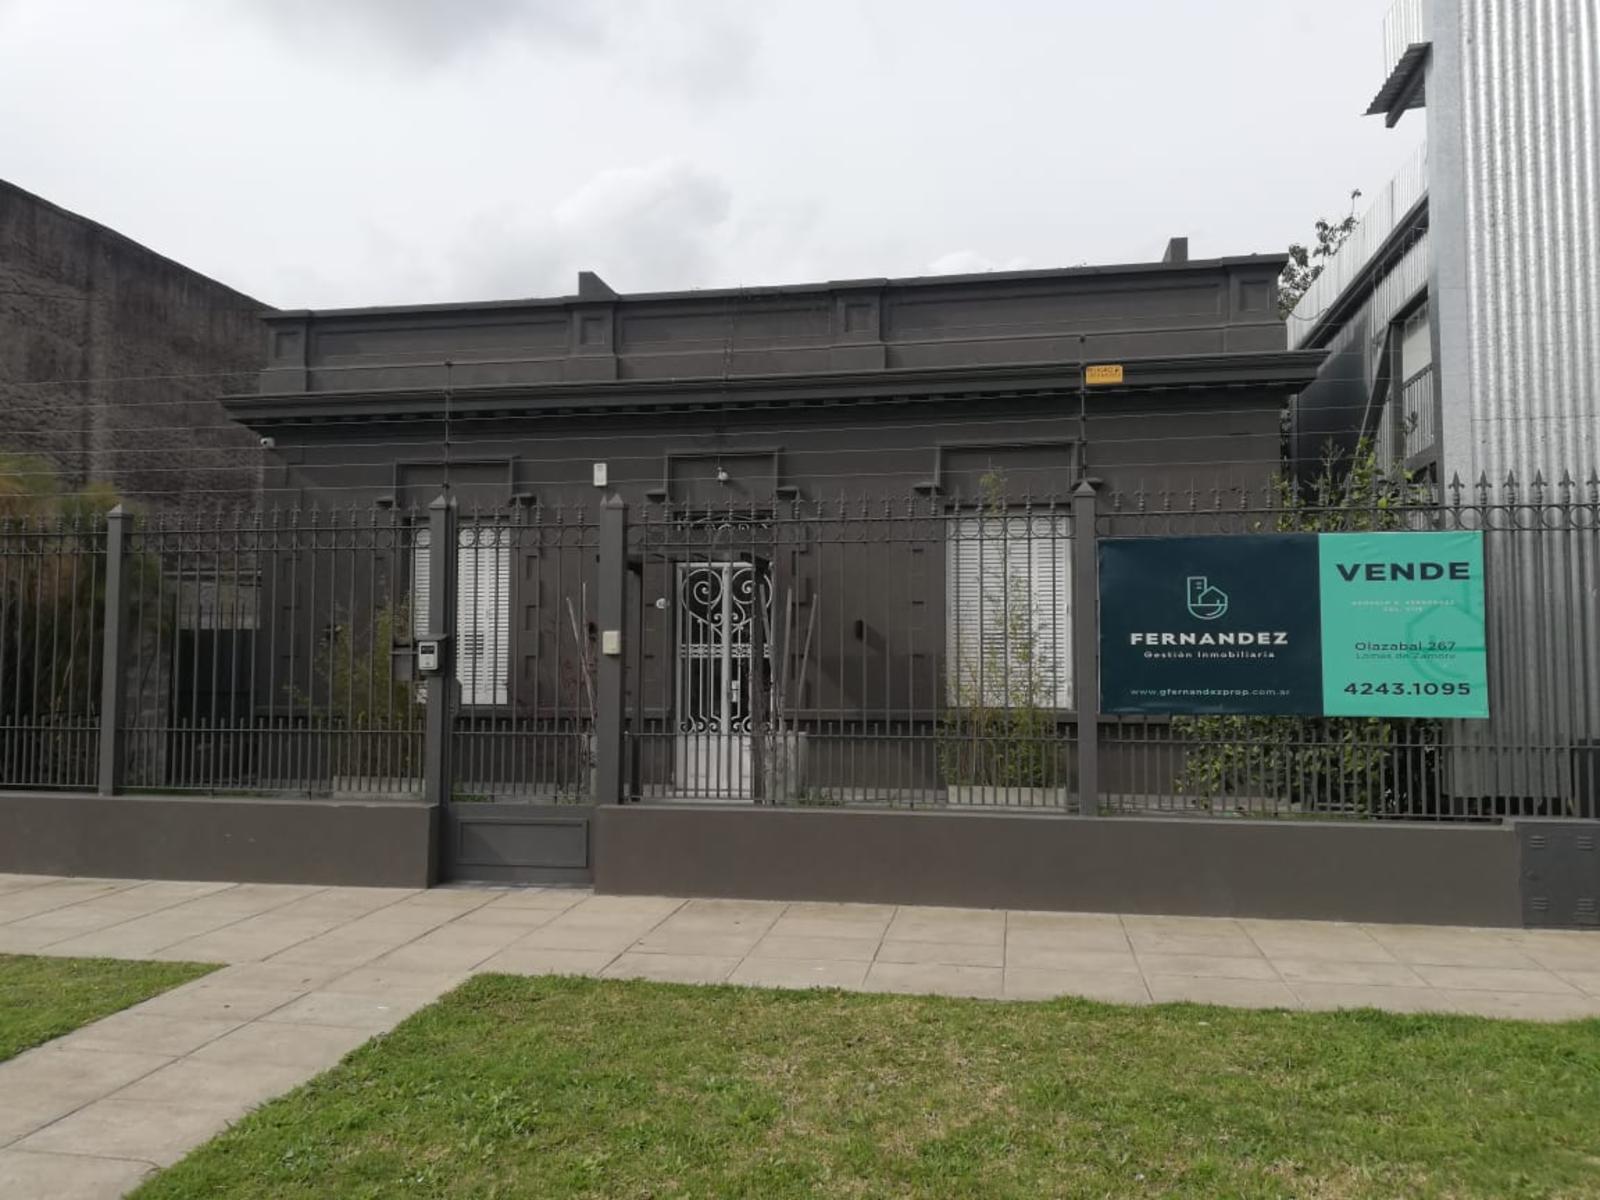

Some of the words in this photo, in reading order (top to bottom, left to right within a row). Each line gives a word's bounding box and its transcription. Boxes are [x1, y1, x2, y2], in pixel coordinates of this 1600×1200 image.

[1336, 562, 1470, 582] VENDE
[1130, 632, 1289, 645] FERNANDEZ
[1355, 640, 1422, 651] Olazabal
[1428, 641, 1456, 652] 267
[1144, 651, 1193, 659] Gestión
[1197, 651, 1275, 659] Inmobiliaria
[1130, 688, 1290, 697] www.gfernandezprop.com.ar
[1344, 682, 1470, 696] 4243.1095
